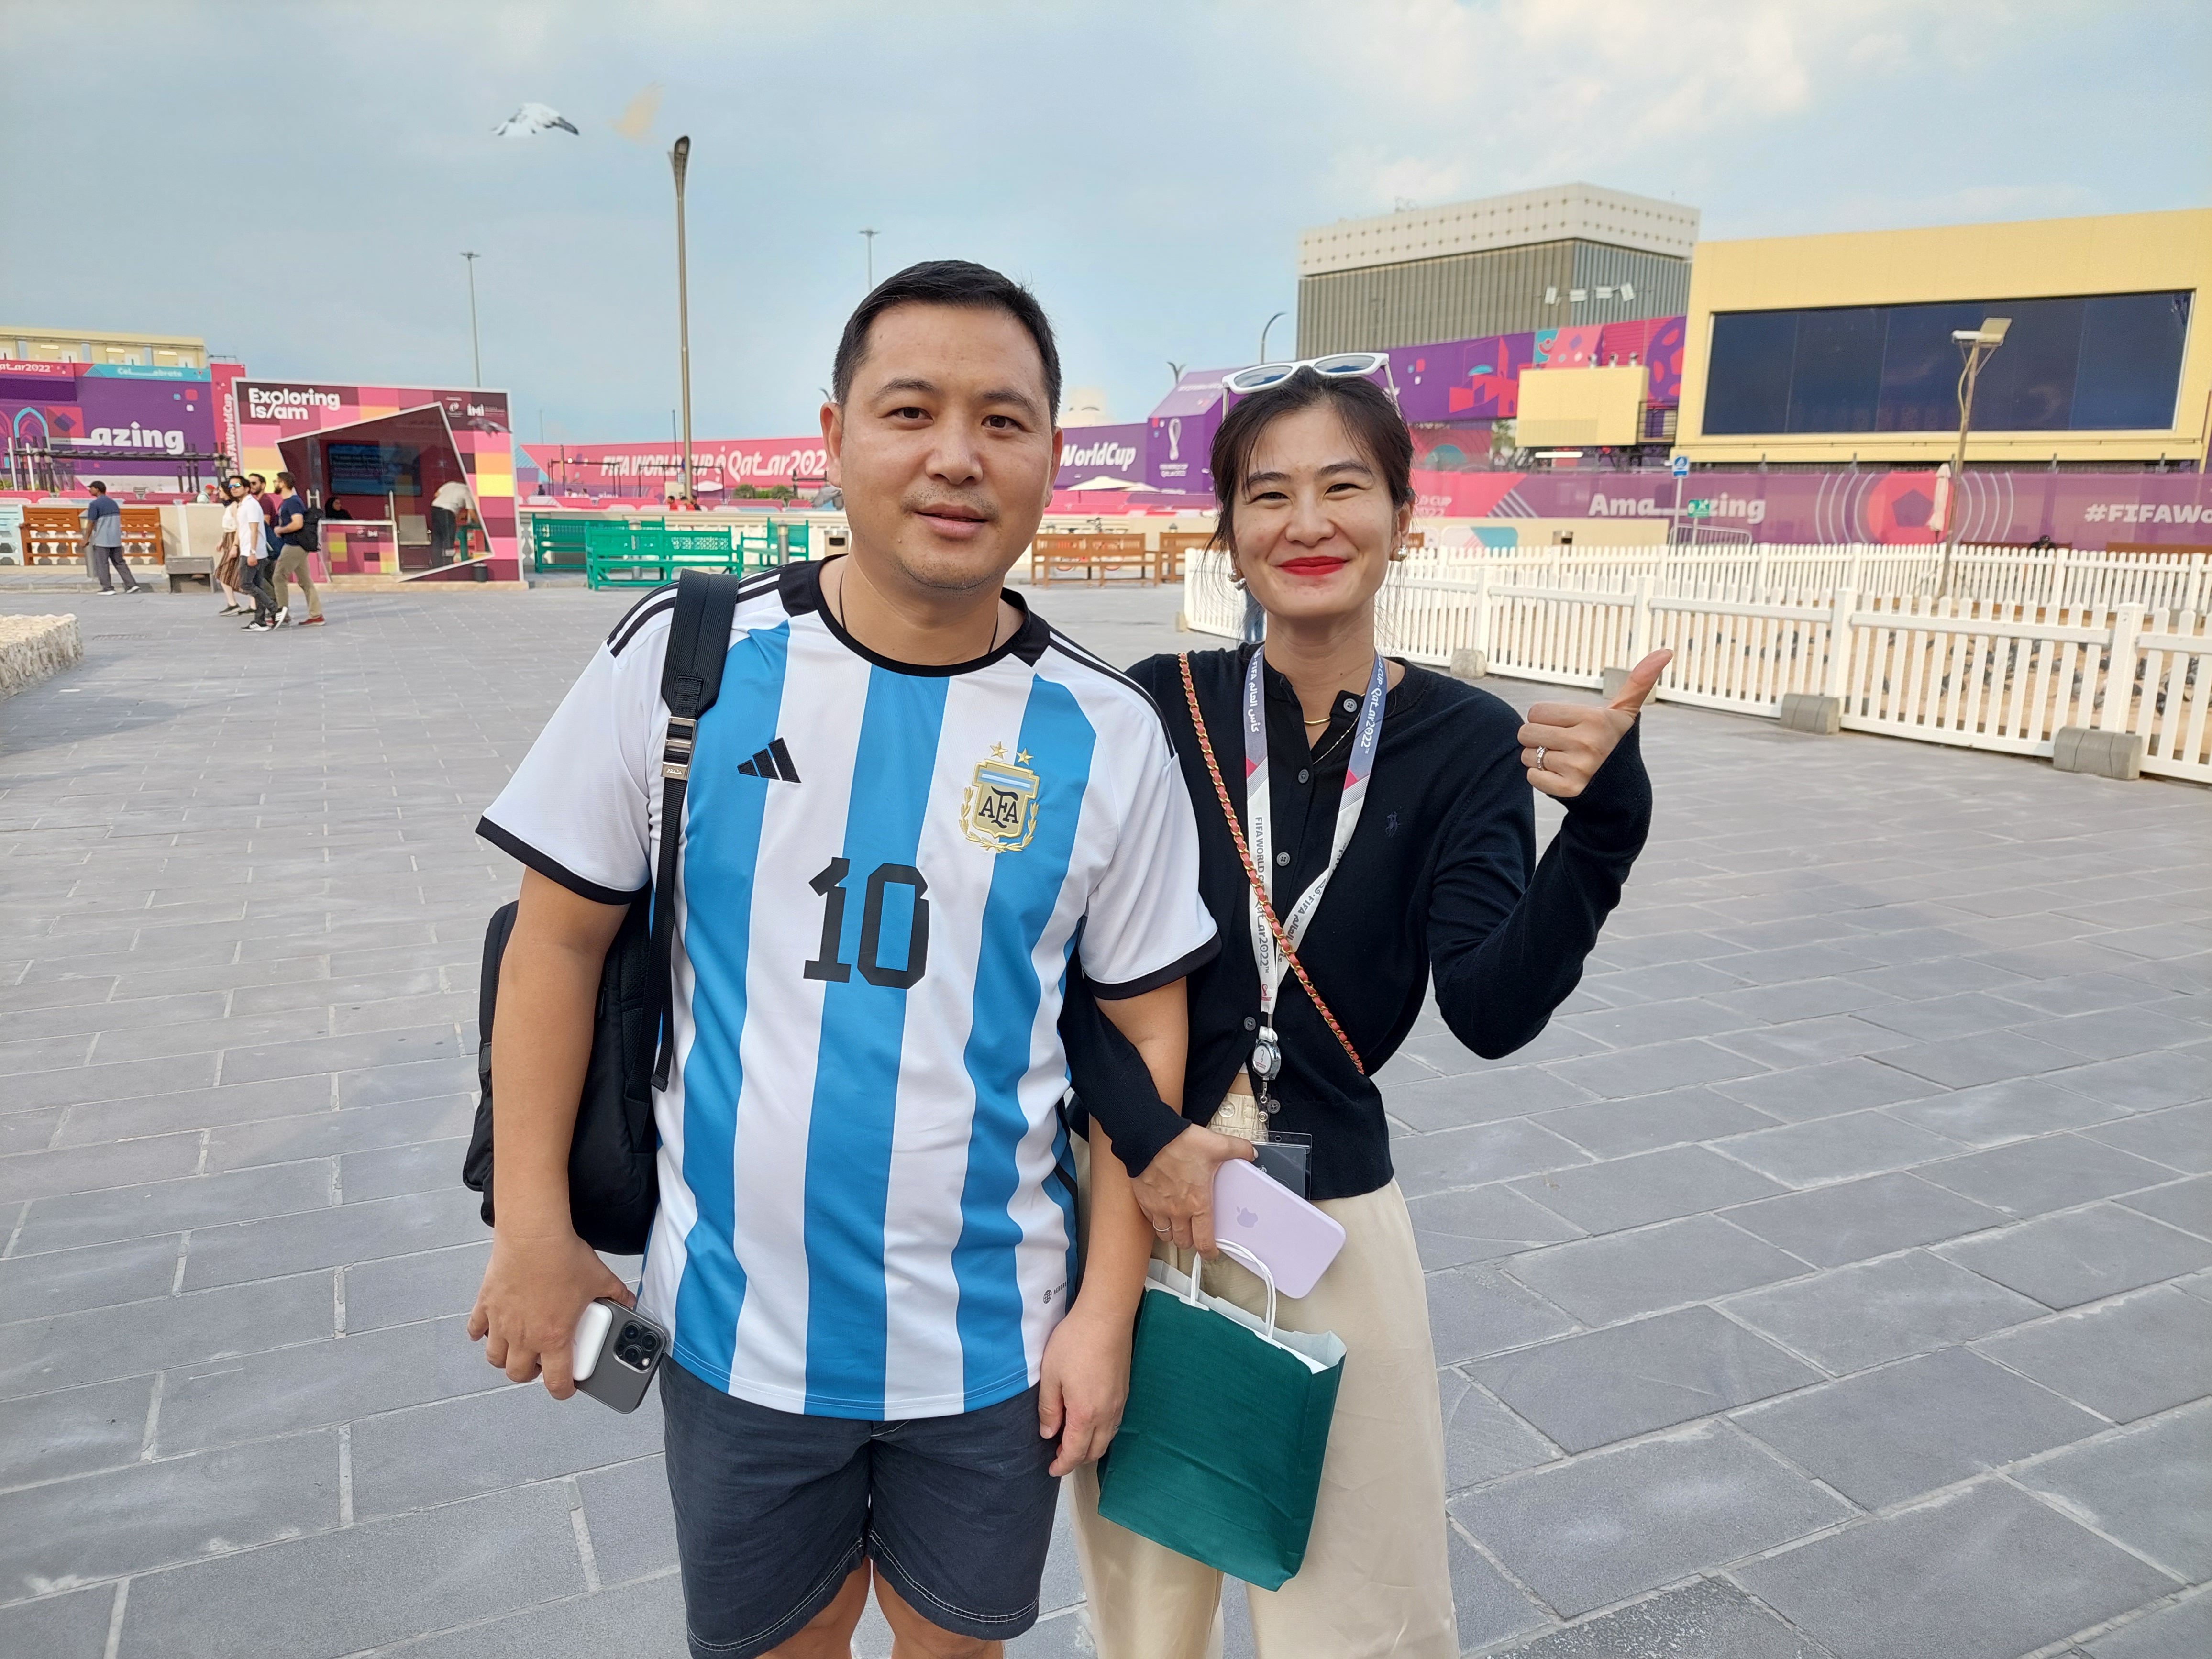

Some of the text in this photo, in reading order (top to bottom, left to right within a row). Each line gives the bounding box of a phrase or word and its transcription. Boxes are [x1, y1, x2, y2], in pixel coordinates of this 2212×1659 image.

[0, 362, 51, 372] atar2022
[601, 455, 630, 476] FIFA
[630, 454, 683, 476] WORLD
[728, 450, 827, 483] Qatar202
[978, 785, 1019, 829] AFA
[1255, 817, 1263, 838] FIFA
[1256, 838, 1265, 873] WORLD
[1297, 895, 1315, 914] FIFA
[803, 856, 930, 990] 10
